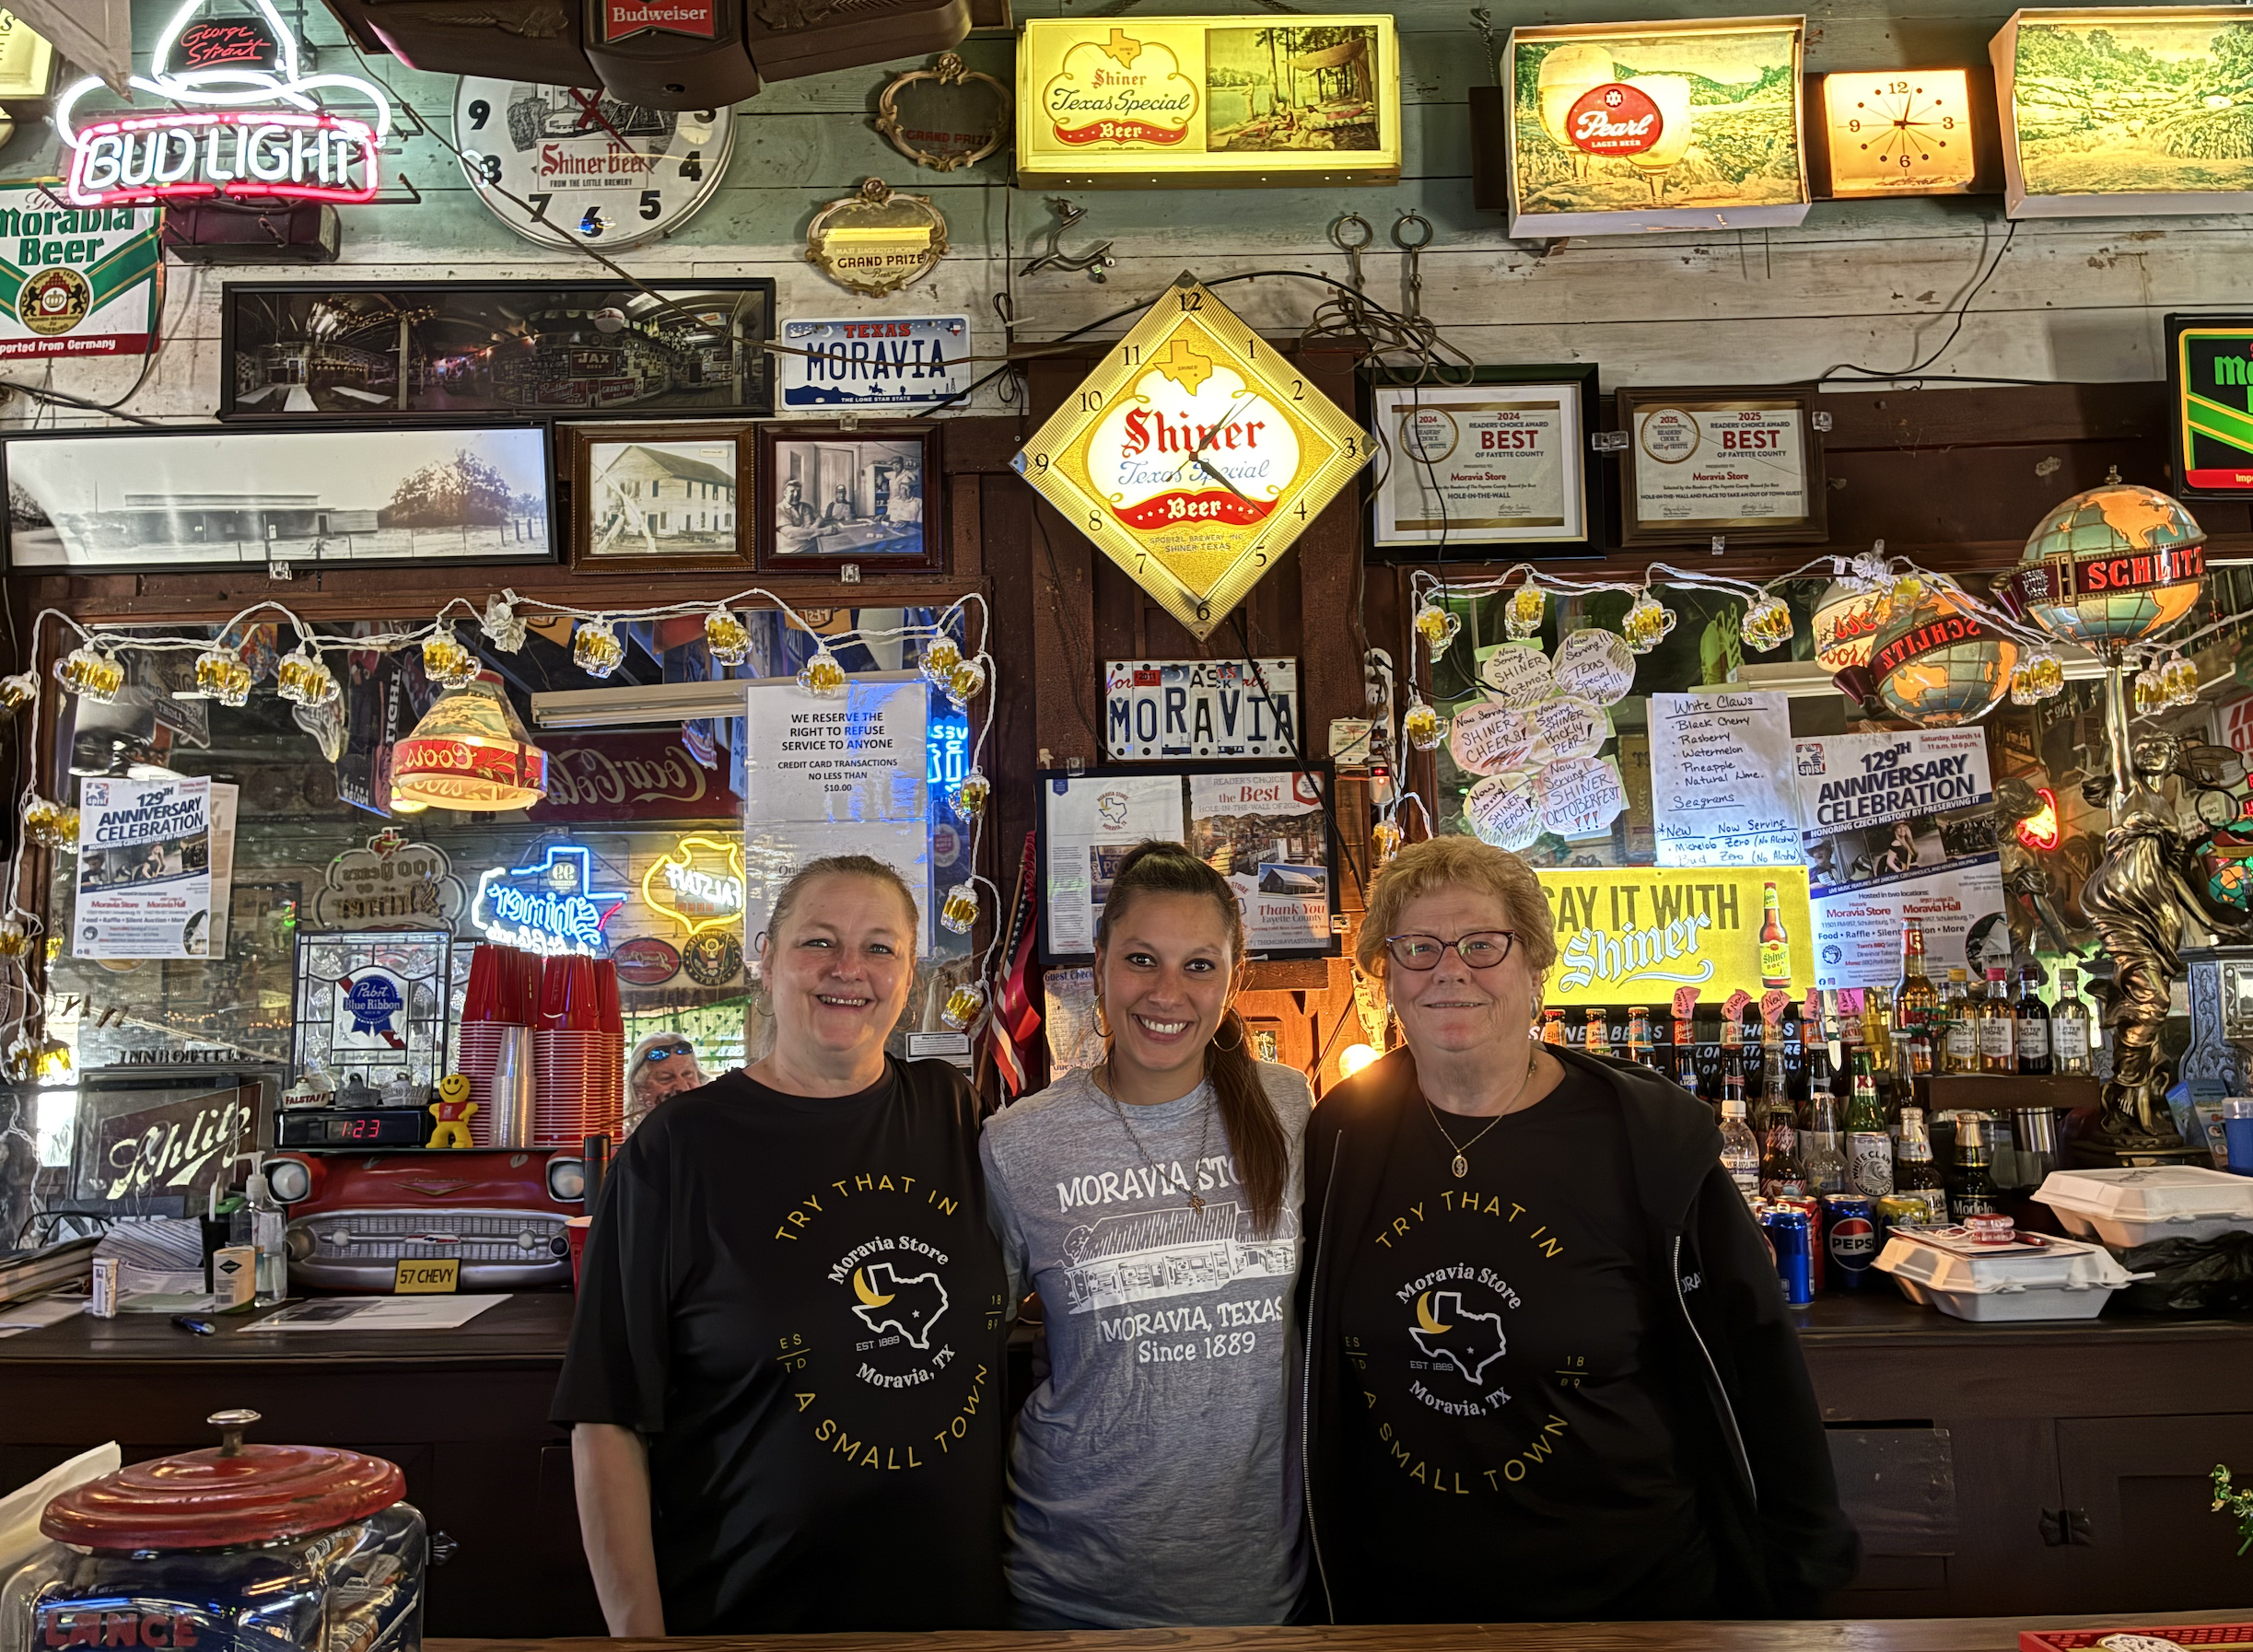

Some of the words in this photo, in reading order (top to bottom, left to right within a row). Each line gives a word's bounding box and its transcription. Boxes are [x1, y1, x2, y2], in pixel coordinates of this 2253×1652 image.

[613, 6, 707, 22] Budweiser
[181, 24, 254, 46] George
[186, 38, 271, 65] Strait
[1091, 68, 1147, 88] Shiner
[1888, 82, 1909, 94] 12
[1052, 88, 1113, 111] Texas
[1115, 90, 1189, 116] Special
[468, 99, 490, 130] 9
[1576, 111, 1654, 138] Pearl
[1943, 117, 1954, 129] 3
[1100, 122, 1142, 138] Beer
[1850, 120, 1861, 132] 9
[84, 128, 197, 188] BUD
[206, 125, 355, 183] LIGHT
[607, 143, 644, 173] Beer
[679, 151, 702, 181] 4
[1899, 155, 1910, 168] 6
[639, 191, 661, 220] 5
[18, 238, 104, 265] Beer
[837, 256, 882, 268] GRAND
[844, 323, 911, 339] TEXAS
[67, 339, 116, 351] Germany
[807, 339, 946, 381] MORAVIA
[1290, 380, 1305, 401] 2
[1080, 390, 1103, 413] 10
[1497, 413, 1520, 421] 2024
[1738, 413, 1761, 421] 2025
[1121, 407, 1266, 459] Shiner
[1481, 430, 1538, 449] BEST
[1722, 430, 1780, 449] BEST
[1035, 453, 1049, 474] 9
[1451, 472, 1483, 482] Moravia
[1485, 472, 1506, 481] Store
[1693, 472, 1725, 482] Moravia
[1727, 472, 1748, 481] Store
[1167, 497, 1222, 519] Beer
[1292, 498, 1308, 521] 4
[1089, 509, 1103, 531] 8
[1165, 543, 1197, 553] SHINER
[1189, 534, 1225, 542] BREWERY
[1135, 553, 1148, 574] 7
[1255, 545, 1267, 566] 5
[2088, 546, 2203, 589] SCHLITZ
[1110, 687, 1294, 743] MORAVIA
[1675, 699, 1711, 714] White
[1717, 695, 1753, 709] Claws
[791, 714, 809, 723] WE
[812, 714, 859, 722] RESERVE
[862, 713, 883, 721] THE
[790, 727, 823, 737] RIGHT
[826, 727, 841, 736] TO
[845, 726, 885, 736] REFUSE
[1678, 732, 1731, 746] Rasberry
[782, 741, 826, 751] SERVICE
[829, 740, 844, 750] TO
[847, 739, 893, 749] ANYONE
[834, 759, 897, 767] TRANSACTIONS
[824, 784, 852, 792] $10.00
[1214, 777, 1251, 785] READER'S
[1253, 775, 1285, 784] CHOICE
[1818, 753, 1969, 804] ANNIVERSARY
[1219, 794, 1236, 803] the
[1240, 785, 1281, 802] Best
[1817, 774, 1975, 826] CELEBRATION
[99, 797, 202, 826] ANNIVERSARY
[1810, 822, 1852, 838] HONORING
[1853, 817, 1877, 829] CZECH
[1878, 811, 1910, 825] HISTORY
[1911, 809, 1922, 819] BY
[1923, 798, 1970, 816] PRESERVING
[1971, 796, 1980, 804] IT
[96, 810, 203, 842] CELEBRATION
[1258, 903, 1299, 915] Thank
[1302, 904, 1325, 913] You
[1610, 885, 1640, 931] IT
[1650, 883, 1740, 930] WITH
[1827, 909, 1865, 918] Moravia
[1866, 907, 1891, 915] Store
[1903, 903, 1942, 913] Moravia
[1943, 902, 1961, 912] Hall
[1292, 914, 1323, 923] County
[1818, 932, 1839, 940] Food
[1846, 930, 1870, 938] Raffle
[1558, 912, 1712, 993] Shiner
[357, 983, 388, 997] Pabst
[344, 999, 366, 1009] Blue
[367, 999, 400, 1009] Ribbon
[342, 1120, 380, 1138] 1:23
[1853, 1153, 1868, 1181] WHITE
[1868, 1151, 1892, 1163] CLAW
[1056, 1160, 1192, 1213] MORAVIA
[1196, 1155, 1246, 1191] STO
[776, 1194, 823, 1240] TRY
[832, 1173, 916, 1197] THAT
[928, 1190, 958, 1216] IN
[1953, 1200, 1993, 1215] Modelo
[1375, 1202, 1425, 1249] TRY
[1441, 1190, 1526, 1223] THAT
[1530, 1226, 1564, 1258] IN
[828, 1236, 895, 1285] Moravia
[899, 1236, 949, 1265] Store
[400, 1270, 415, 1284] 57
[417, 1268, 455, 1284] CHEVY
[1395, 1262, 1475, 1304] Moravia
[1477, 1267, 1522, 1309] Store
[1101, 1307, 1212, 1343] MORAVIA,
[1217, 1296, 1284, 1328] TEXAS
[879, 1335, 900, 1348] 1889
[1138, 1340, 1197, 1363] Since
[1205, 1332, 1255, 1359] 1889
[856, 1362, 935, 1389] Moravia,
[932, 1344, 955, 1369] TX
[1432, 1362, 1453, 1371] 1889
[1408, 1380, 1487, 1416] Moravia,
[1485, 1387, 1512, 1409] TX
[815, 1418, 923, 1470] SMALL
[934, 1363, 987, 1453] TOWN
[1380, 1423, 1470, 1495] SMALL
[1483, 1414, 1569, 1492] TOWN
[44, 1612, 199, 1648] LANCE
